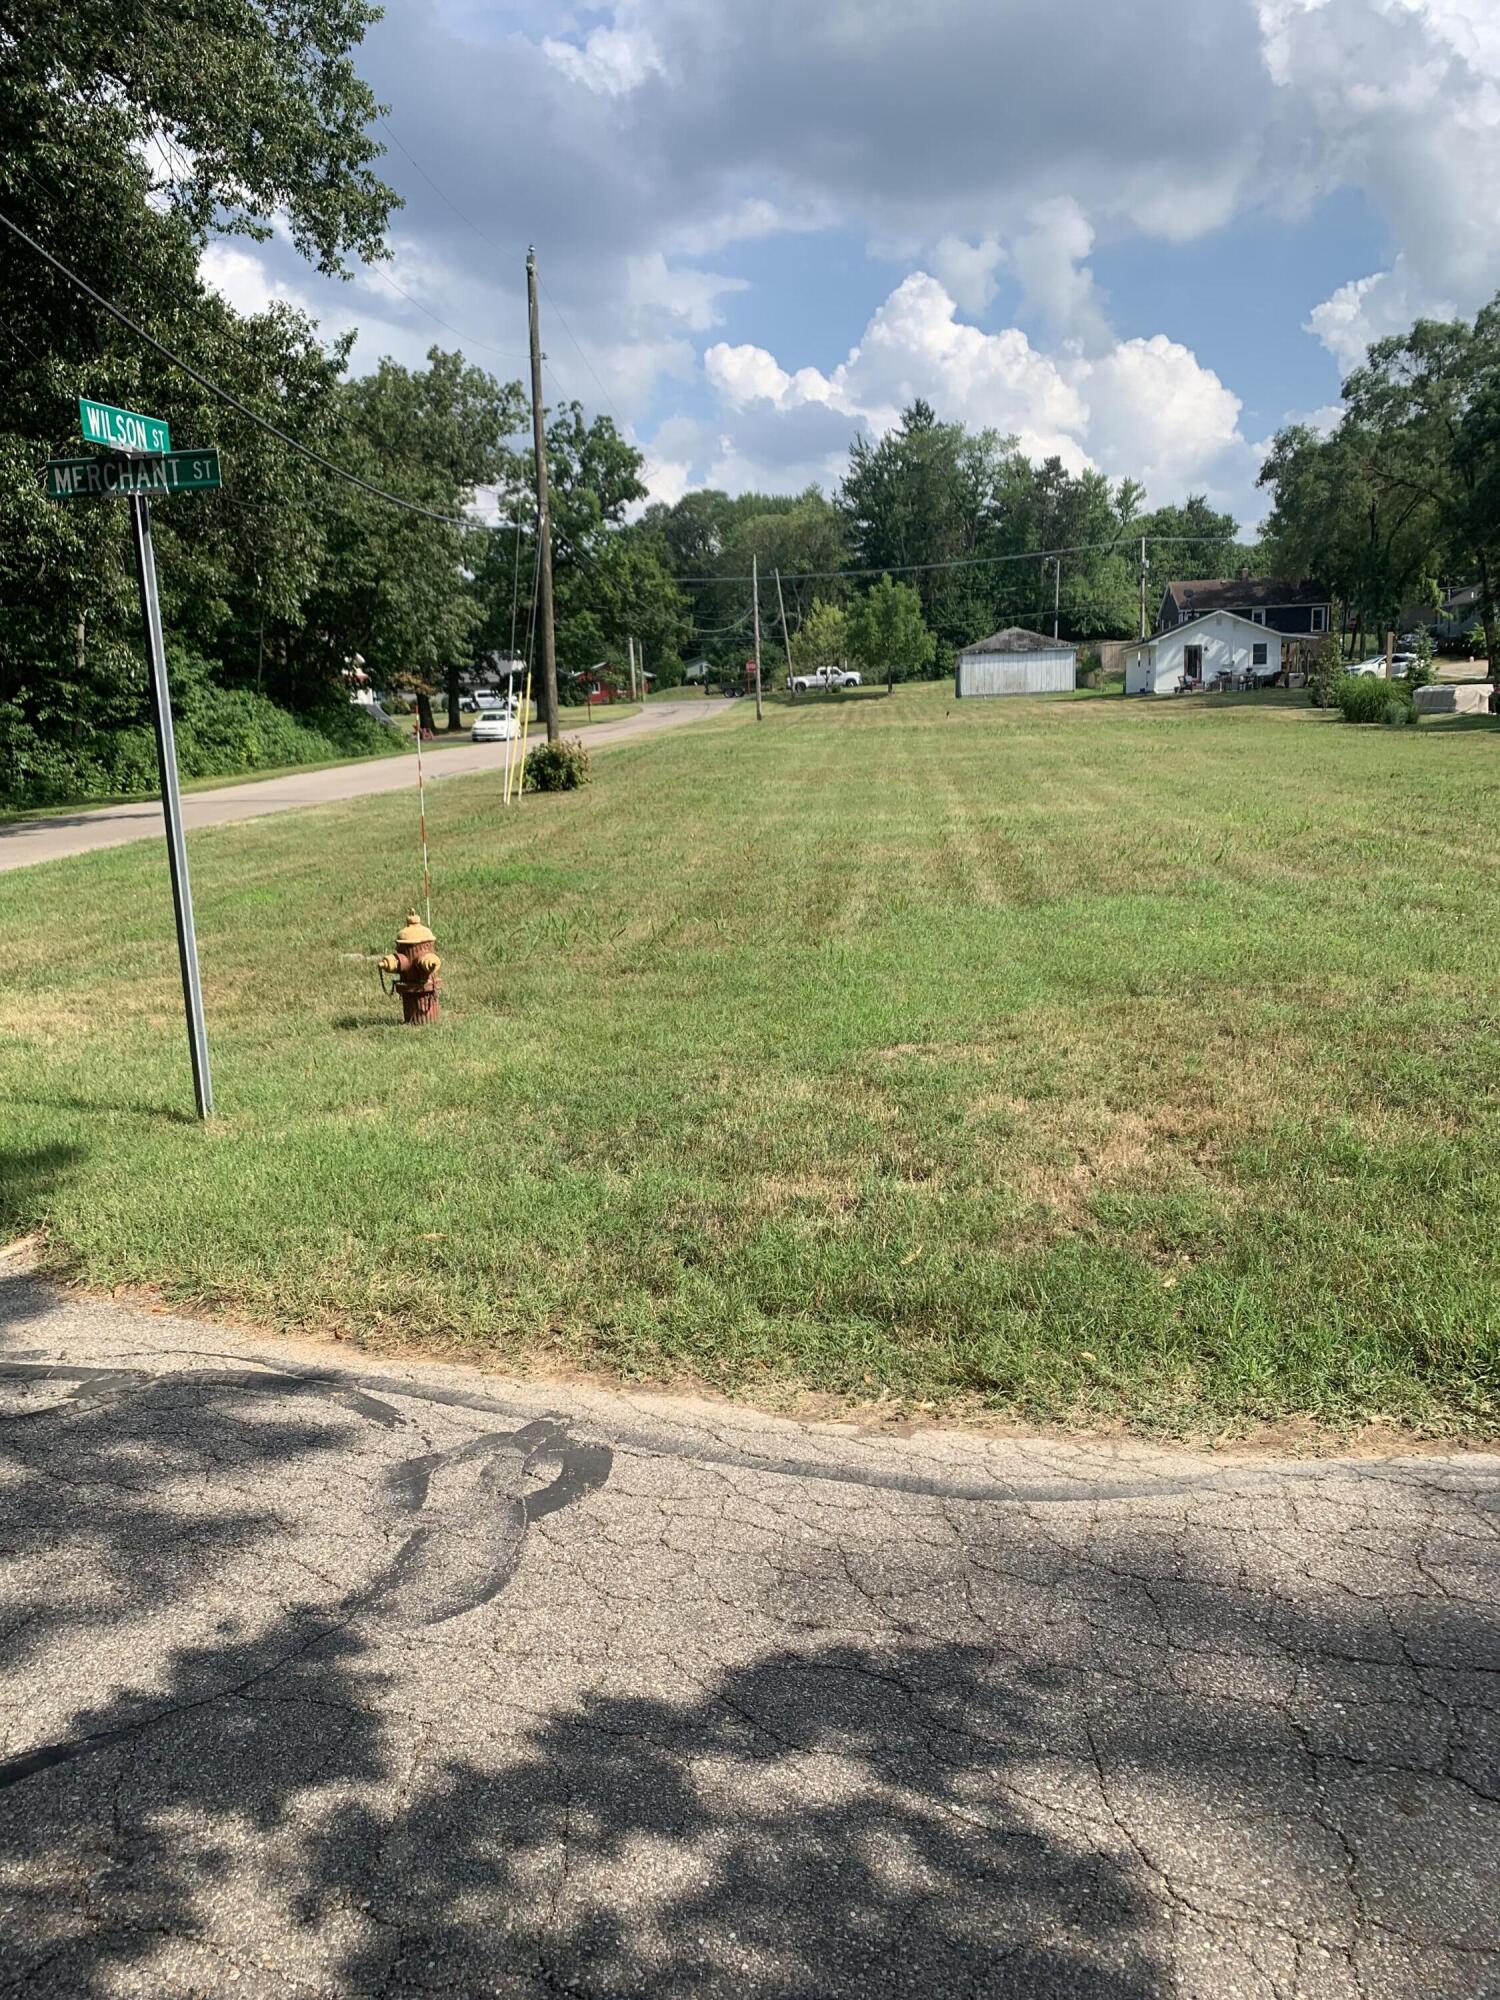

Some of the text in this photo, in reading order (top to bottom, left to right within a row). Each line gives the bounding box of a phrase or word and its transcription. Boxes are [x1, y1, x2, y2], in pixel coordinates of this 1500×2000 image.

[86, 406, 165, 449] WILSON ST
[54, 459, 212, 494] MERCHANT ST
